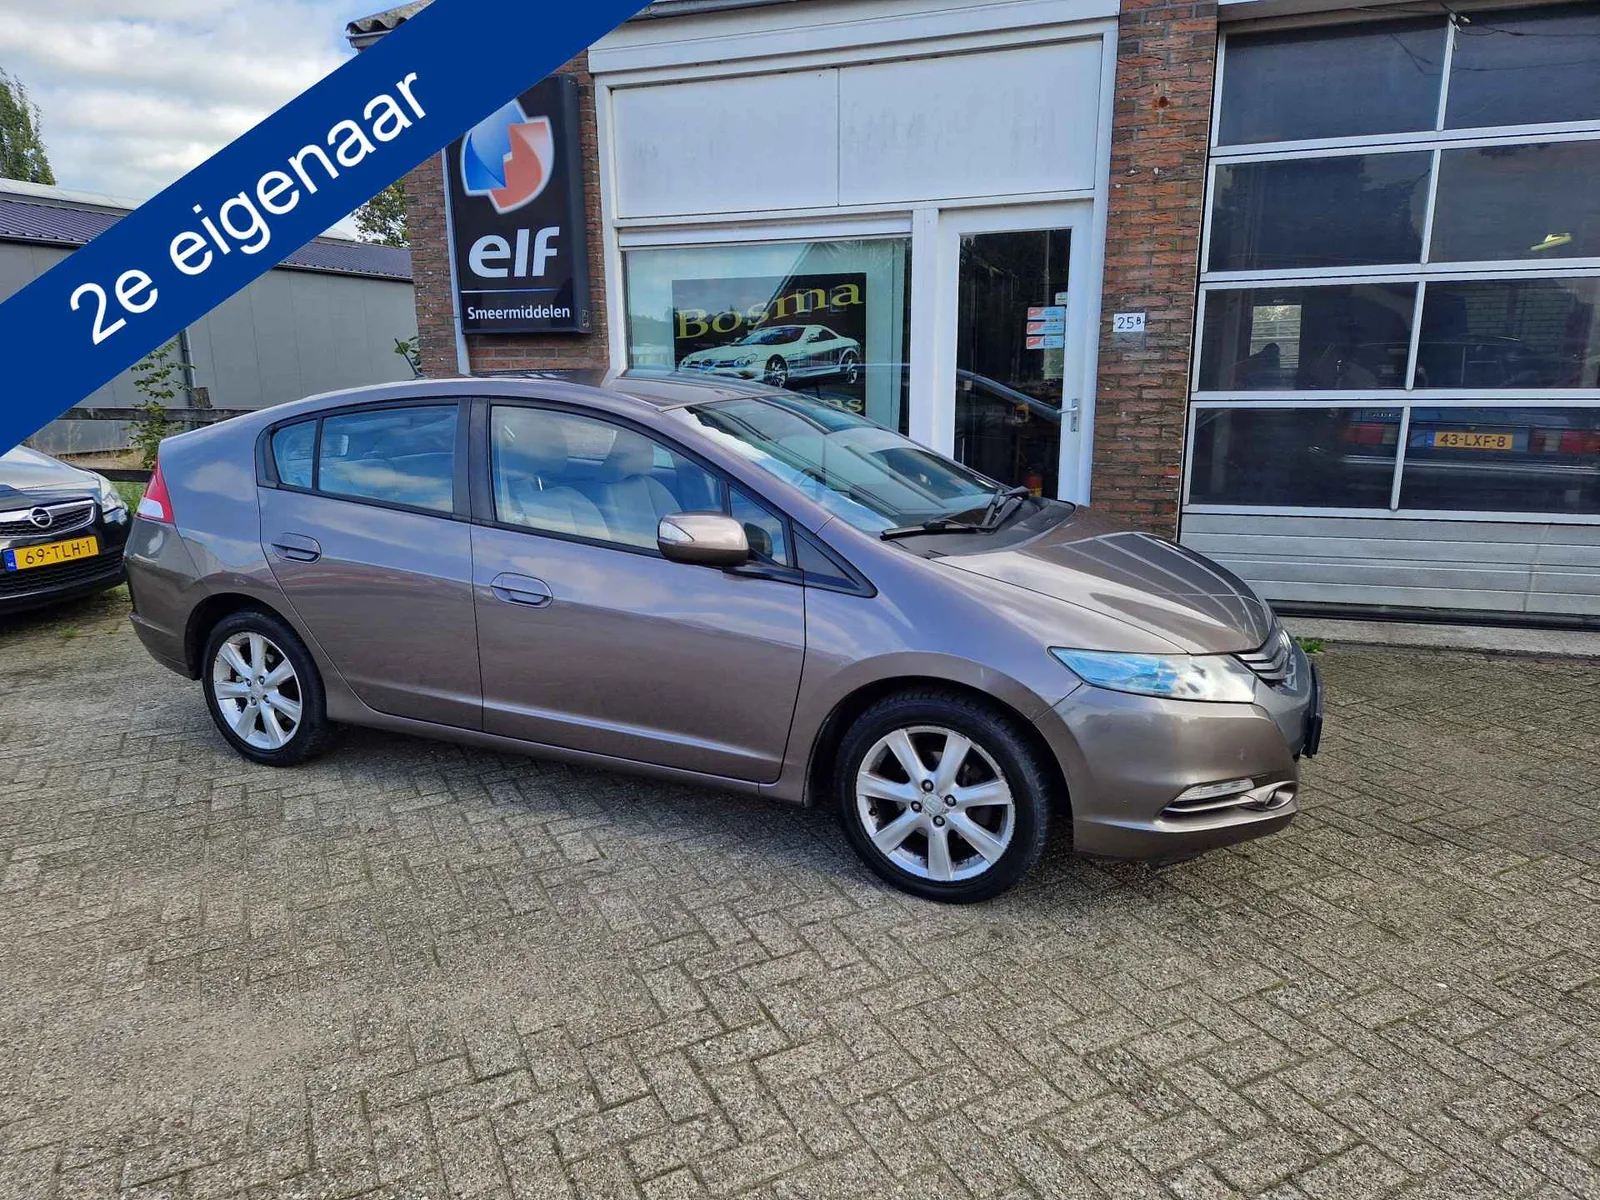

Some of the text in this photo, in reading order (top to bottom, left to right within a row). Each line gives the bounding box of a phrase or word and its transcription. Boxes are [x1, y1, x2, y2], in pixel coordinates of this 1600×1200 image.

[468, 226, 560, 278] elf
[467, 304, 571, 320] Smeermiddelen
[676, 283, 864, 339] Bosma
[1439, 433, 1506, 448] 43-LXF-8
[25, 540, 91, 564] 69-TLH-1
